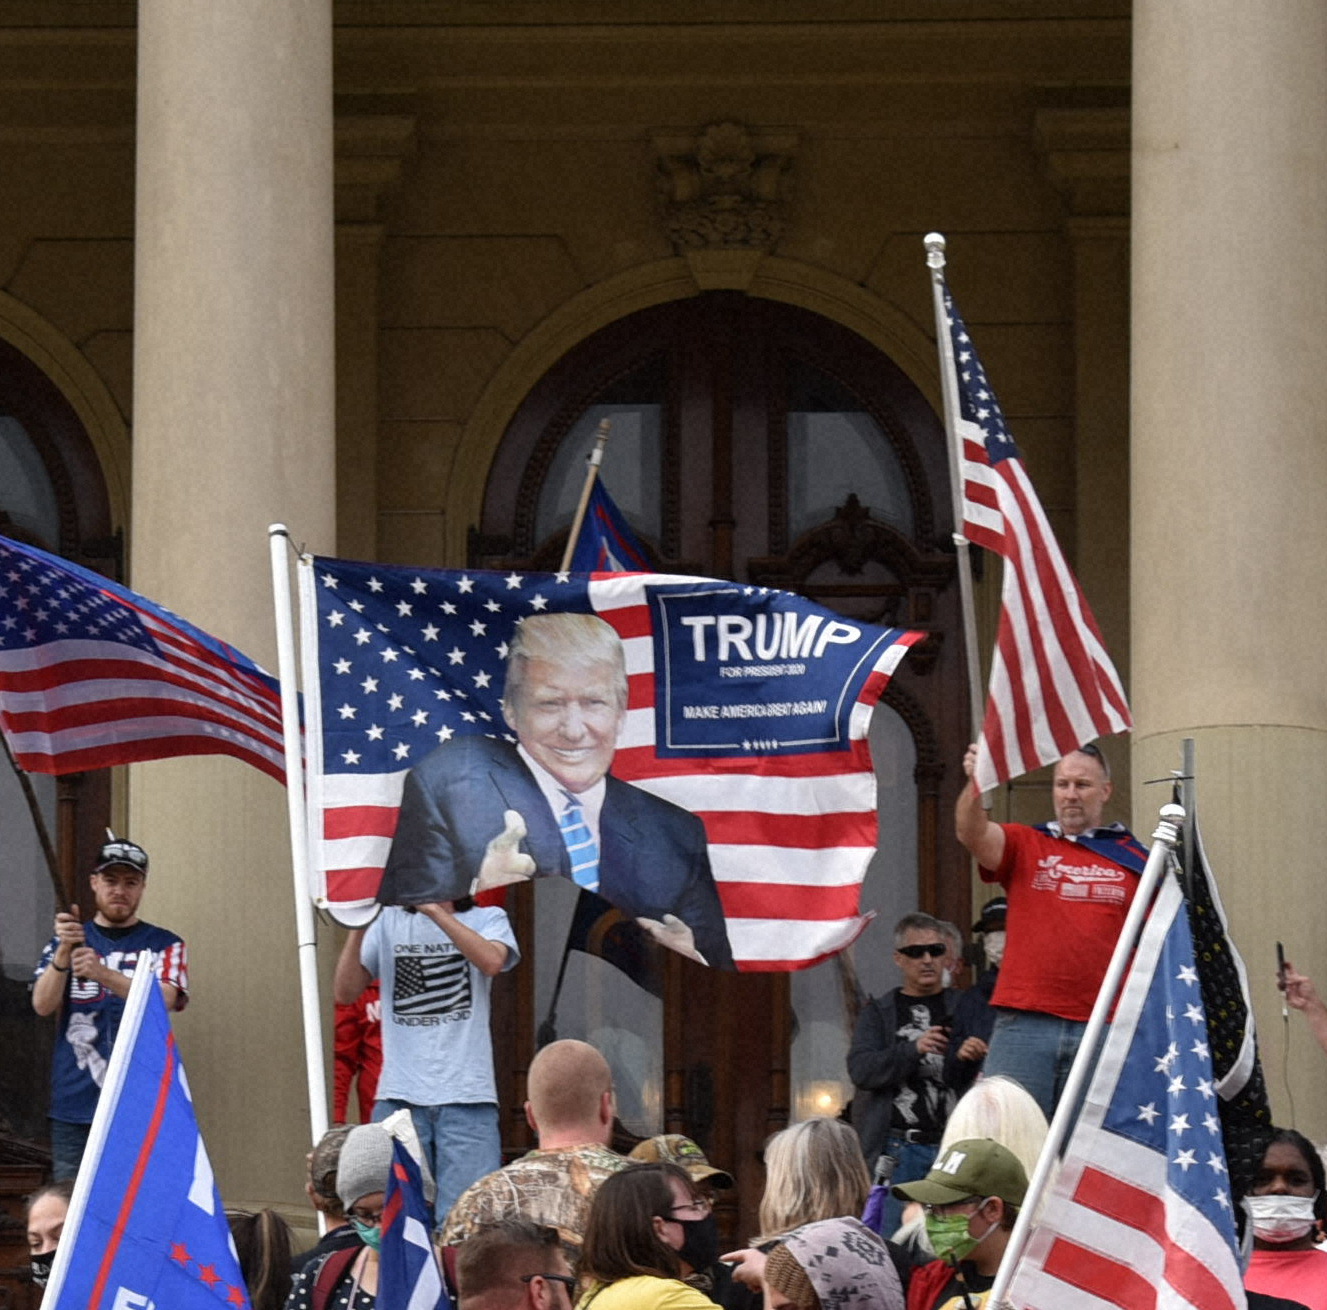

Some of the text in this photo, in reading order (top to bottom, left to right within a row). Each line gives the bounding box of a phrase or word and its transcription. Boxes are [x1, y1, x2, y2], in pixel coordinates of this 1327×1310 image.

[680, 611, 862, 662] TRUMP
[683, 705, 720, 719] MAKE
[1037, 855, 1126, 884] America
[394, 944, 421, 954] ONE
[393, 1015, 441, 1027] UNDER
